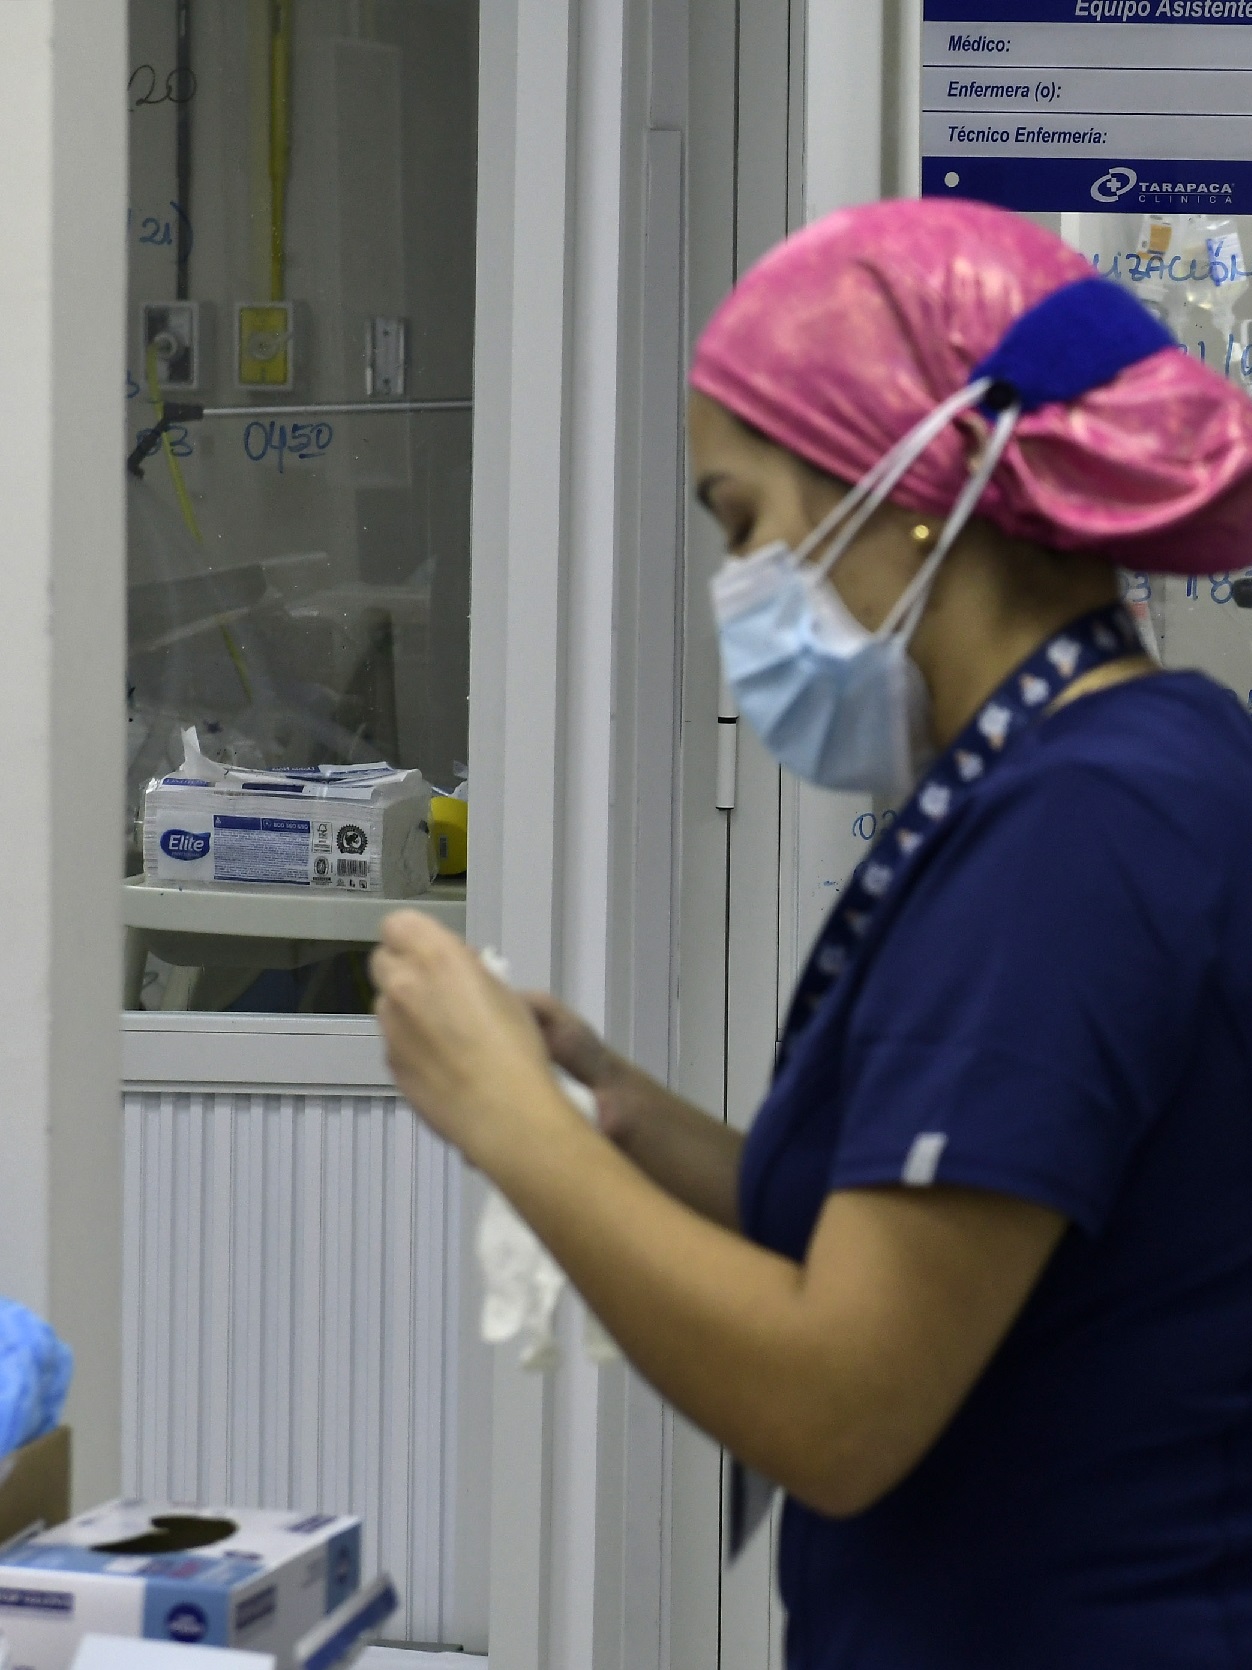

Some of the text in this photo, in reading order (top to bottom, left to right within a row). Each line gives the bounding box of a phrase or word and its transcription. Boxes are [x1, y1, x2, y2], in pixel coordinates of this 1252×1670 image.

[1075, 0, 1151, 21] Equipo
[948, 35, 1011, 53] Médico:
[947, 81, 1062, 102] Enfermera (o):
[948, 125, 1107, 145] Técnico Enfermería:
[1138, 182, 1233, 194] TARAPACA
[1138, 195, 1233, 204] CLINICA
[168, 834, 205, 852] Elite
